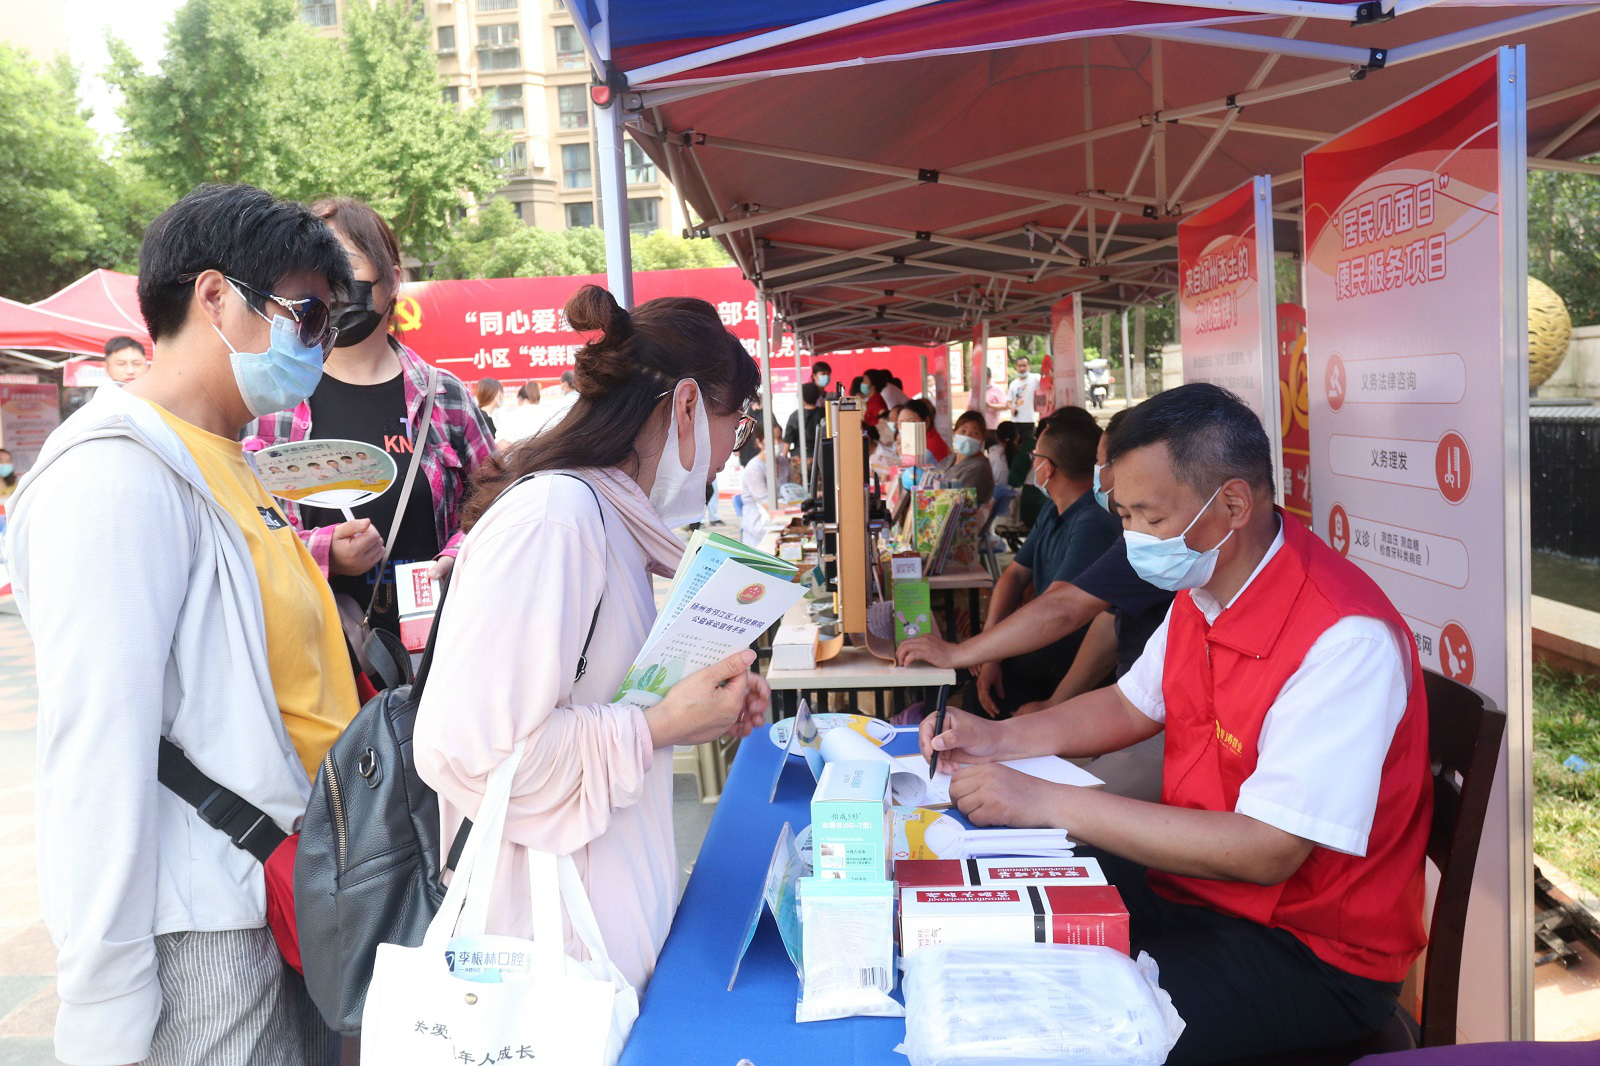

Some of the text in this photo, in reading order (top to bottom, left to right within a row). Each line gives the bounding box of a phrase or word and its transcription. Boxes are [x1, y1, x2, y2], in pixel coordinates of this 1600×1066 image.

[1333, 173, 1449, 250] “居民见面日”
[1185, 244, 1249, 297] 来自扬州本土的
[1336, 232, 1446, 301] 便民服务项目
[717, 300, 771, 327] 部年
[1361, 371, 1416, 391] 义务法律咨询
[1371, 449, 1408, 470] 义务理发
[1381, 531, 1399, 546] 测血压
[1401, 536, 1420, 551] 测血糖
[1380, 545, 1422, 566] 检查牙科类病症
[689, 602, 765, 629] 扬州市邗江区人民检察院
[691, 615, 747, 635] 公益诉讼宣传手册
[458, 951, 525, 967] 李根林口腔
